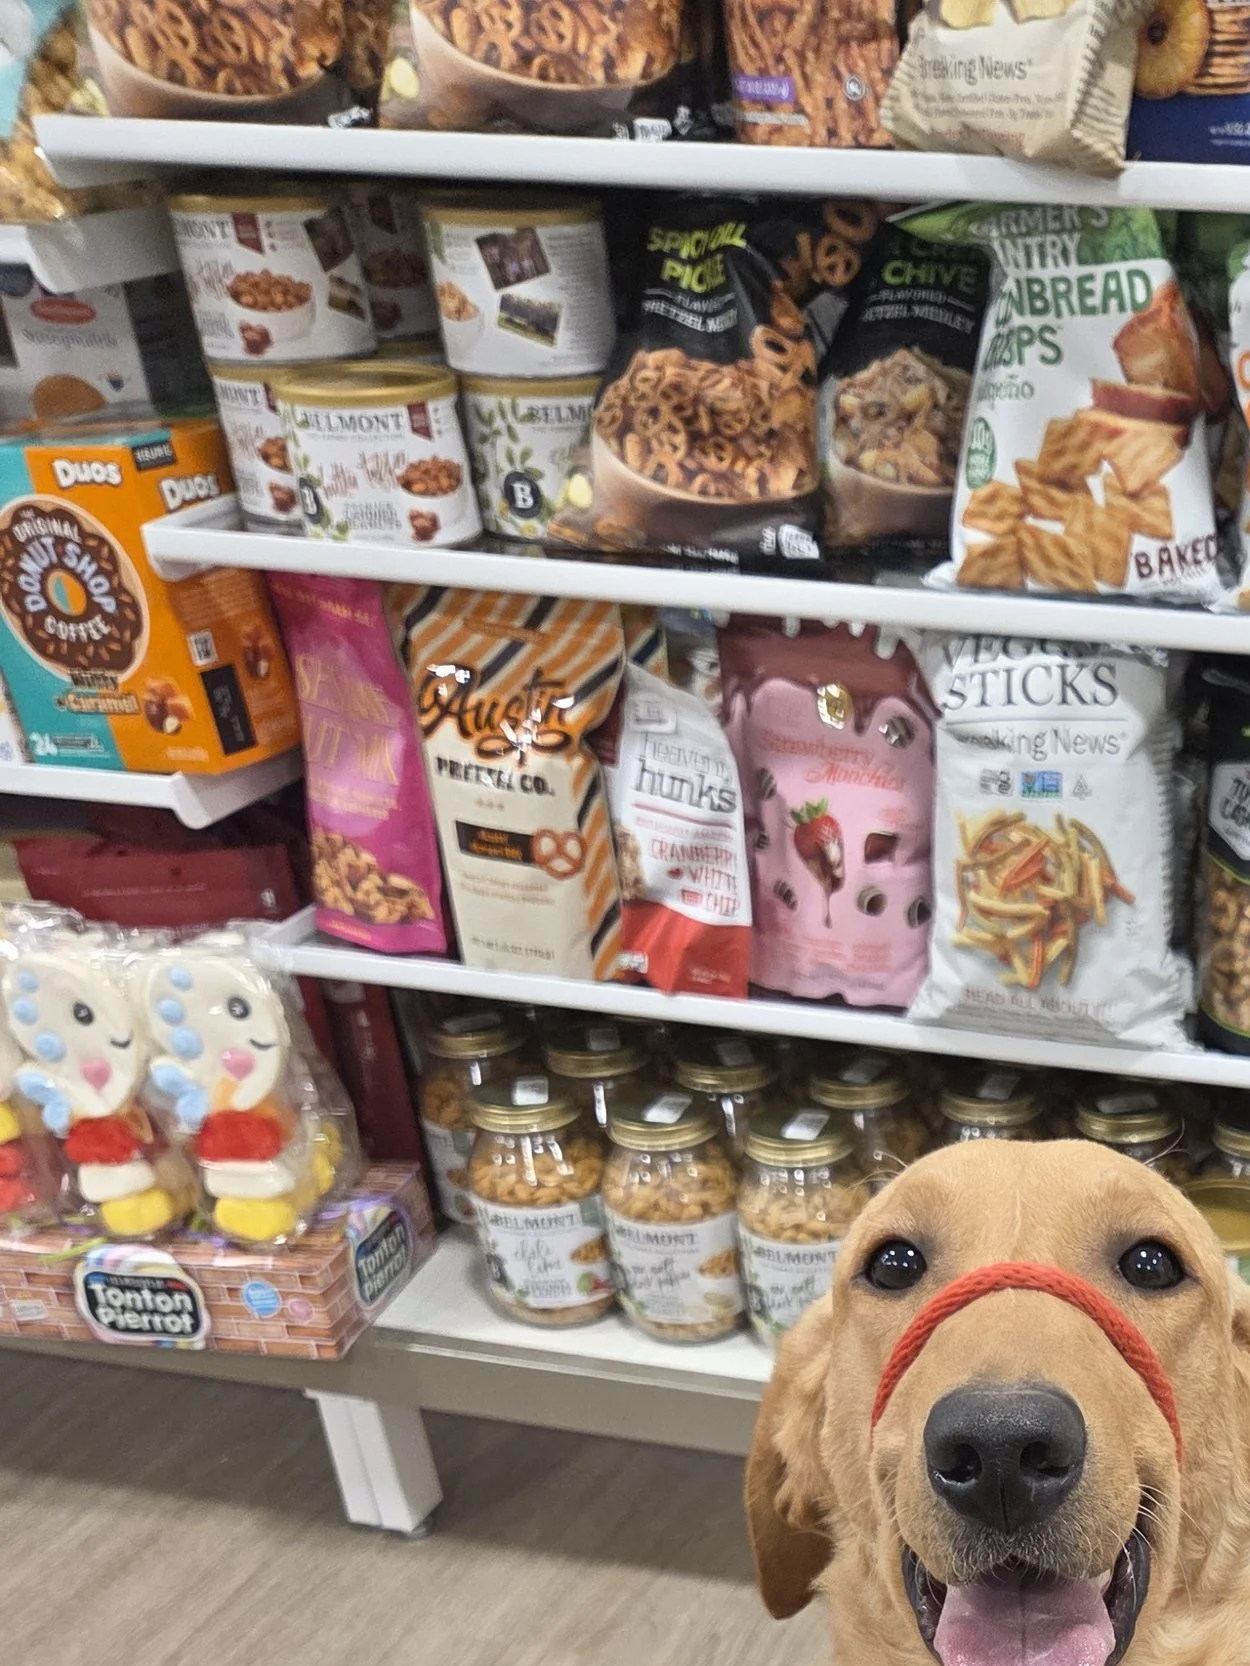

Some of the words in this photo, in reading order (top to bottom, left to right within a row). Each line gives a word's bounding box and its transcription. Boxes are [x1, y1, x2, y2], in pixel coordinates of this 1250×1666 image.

[881, 259, 980, 294] CHIVE
[941, 662, 1119, 712] STICKS
[1053, 728, 1121, 755] News
[634, 758, 738, 814] hunks
[90, 1283, 193, 1313] Tonton
[98, 1306, 196, 1336] Pierrot
